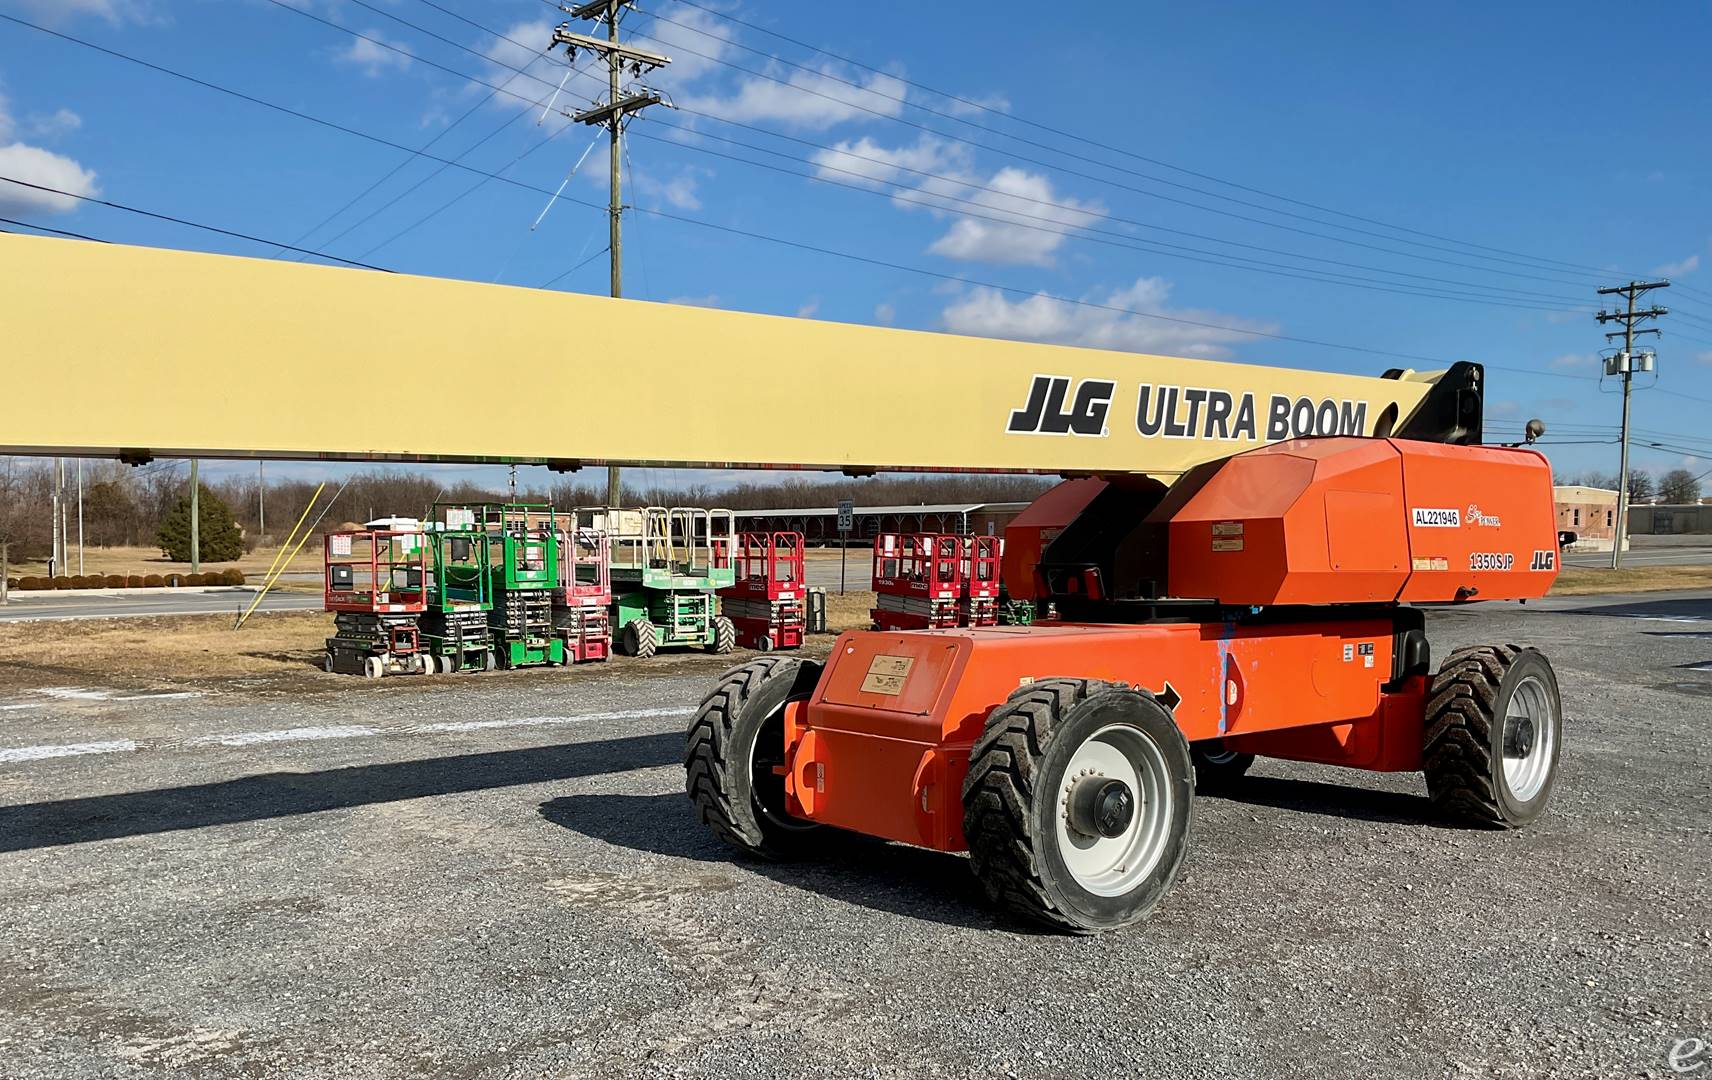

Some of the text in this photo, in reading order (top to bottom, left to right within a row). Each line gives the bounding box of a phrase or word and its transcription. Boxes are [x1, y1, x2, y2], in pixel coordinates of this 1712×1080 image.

[1007, 375, 1116, 435] JLG
[1136, 384, 1367, 440] ULTRA BOOM
[839, 515, 851, 527] 35
[1416, 510, 1458, 525] AL221946
[1470, 553, 1513, 571] 1350SJP
[1531, 551, 1554, 571] JLG
